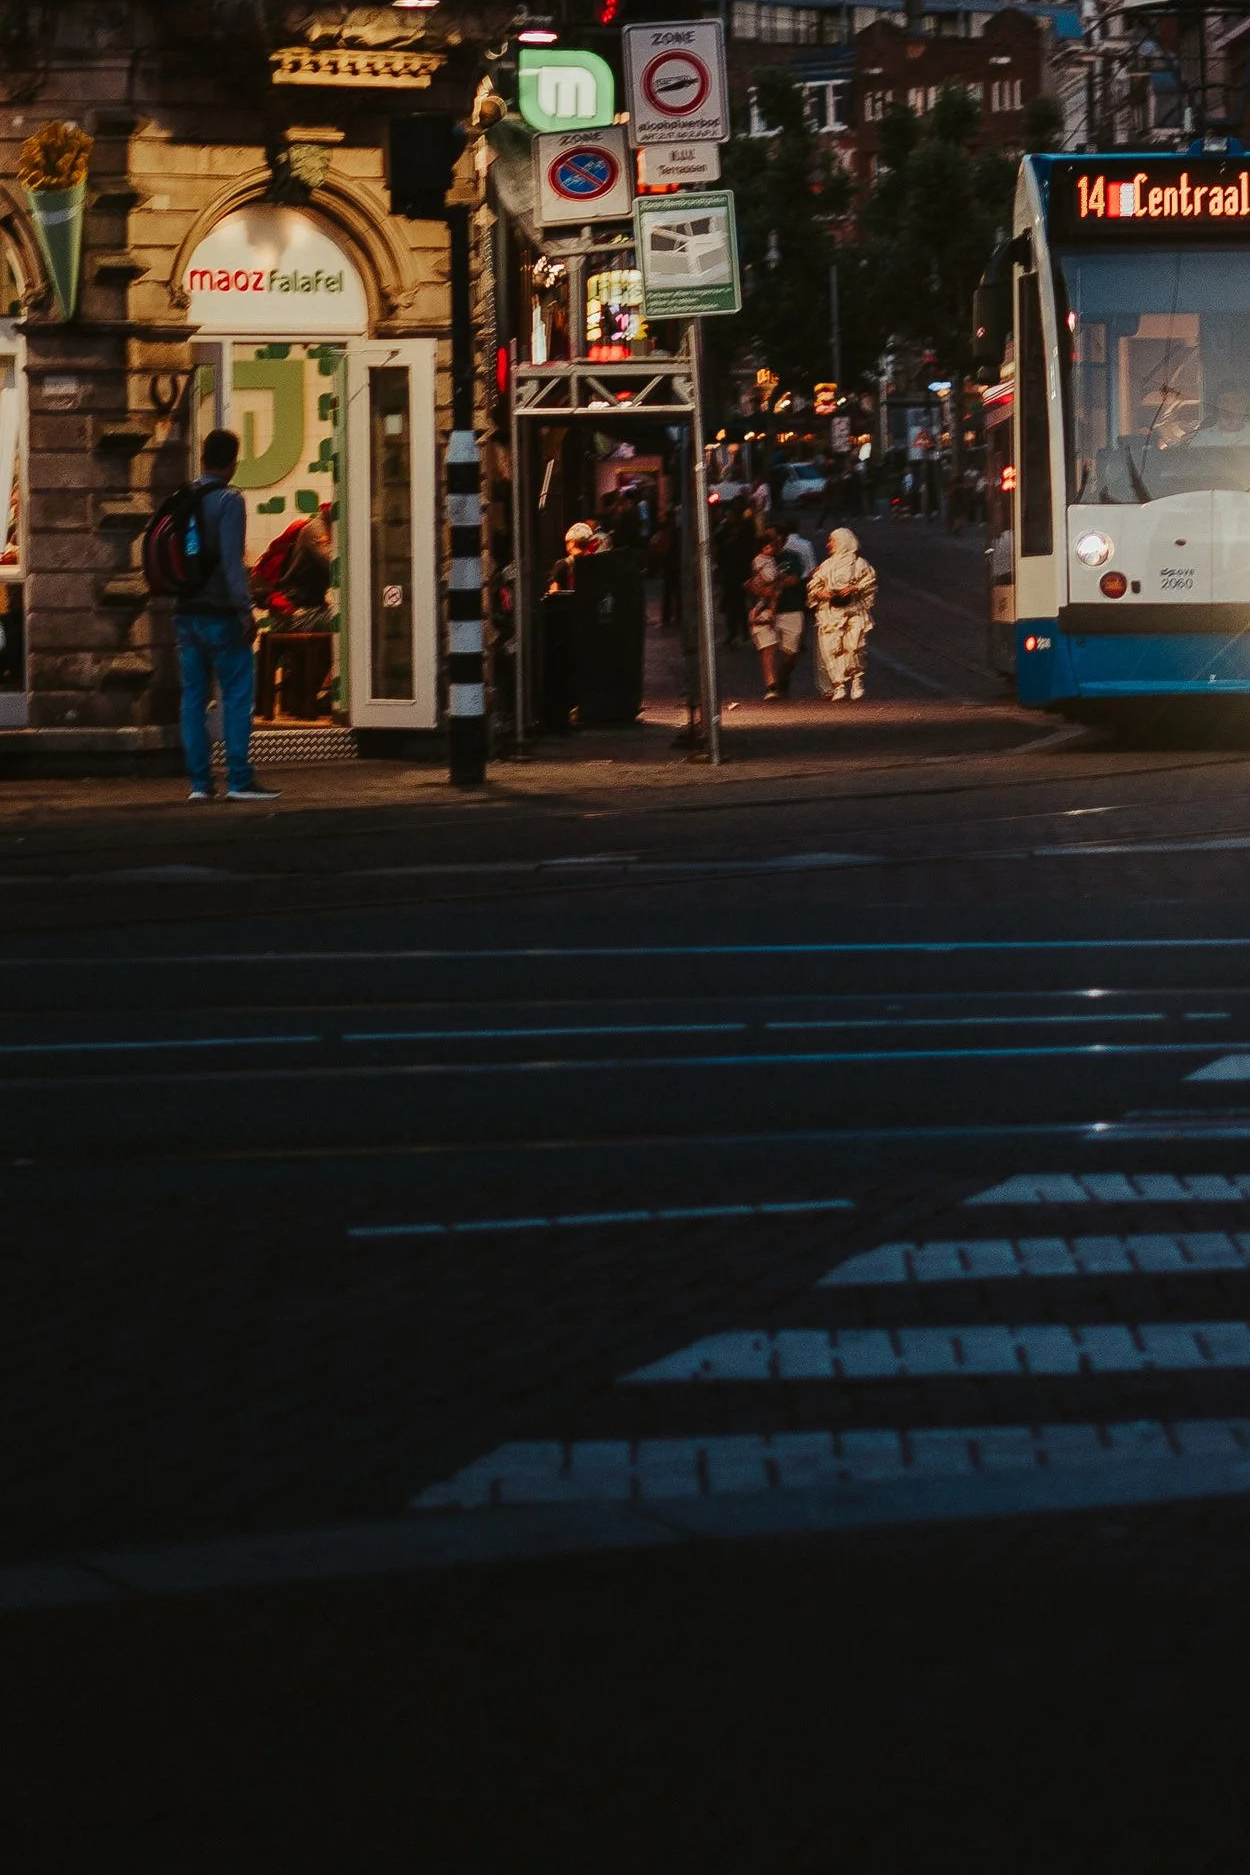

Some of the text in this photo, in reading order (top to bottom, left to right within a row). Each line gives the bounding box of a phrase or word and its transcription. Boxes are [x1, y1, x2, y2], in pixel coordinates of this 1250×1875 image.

[651, 30, 696, 46] ZONE
[559, 131, 603, 146] ZONE
[1077, 175, 1106, 217] 14
[1133, 171, 1250, 217] Centraal
[189, 268, 344, 293] maoz falafel
[1160, 578, 1194, 590] 2060
